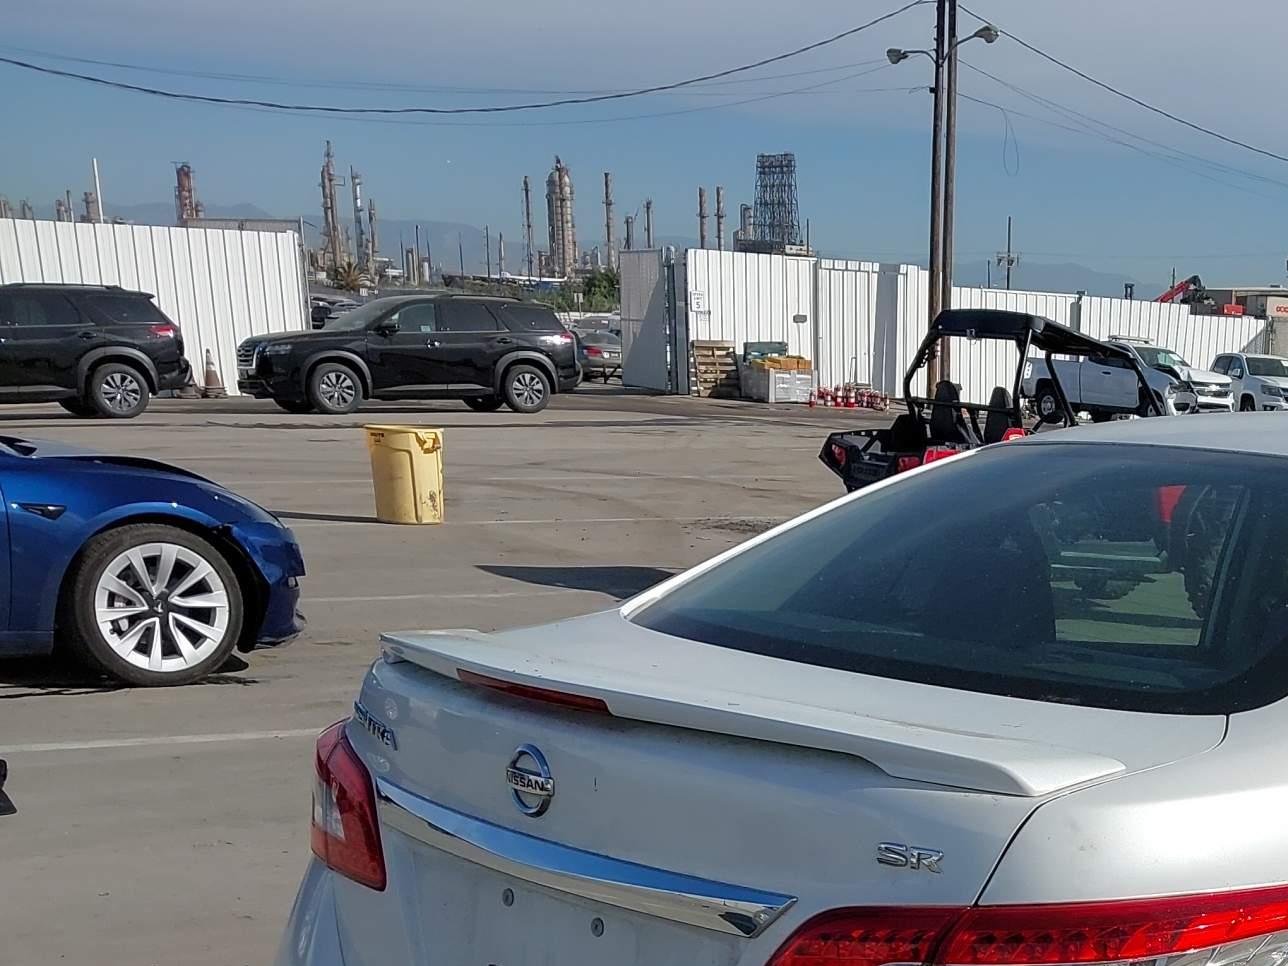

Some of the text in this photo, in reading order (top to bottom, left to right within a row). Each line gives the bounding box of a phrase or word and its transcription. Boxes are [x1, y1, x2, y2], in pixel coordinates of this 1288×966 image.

[696, 301, 701, 309] 5
[506, 769, 545, 792] NISSAN
[877, 842, 945, 873] SR
